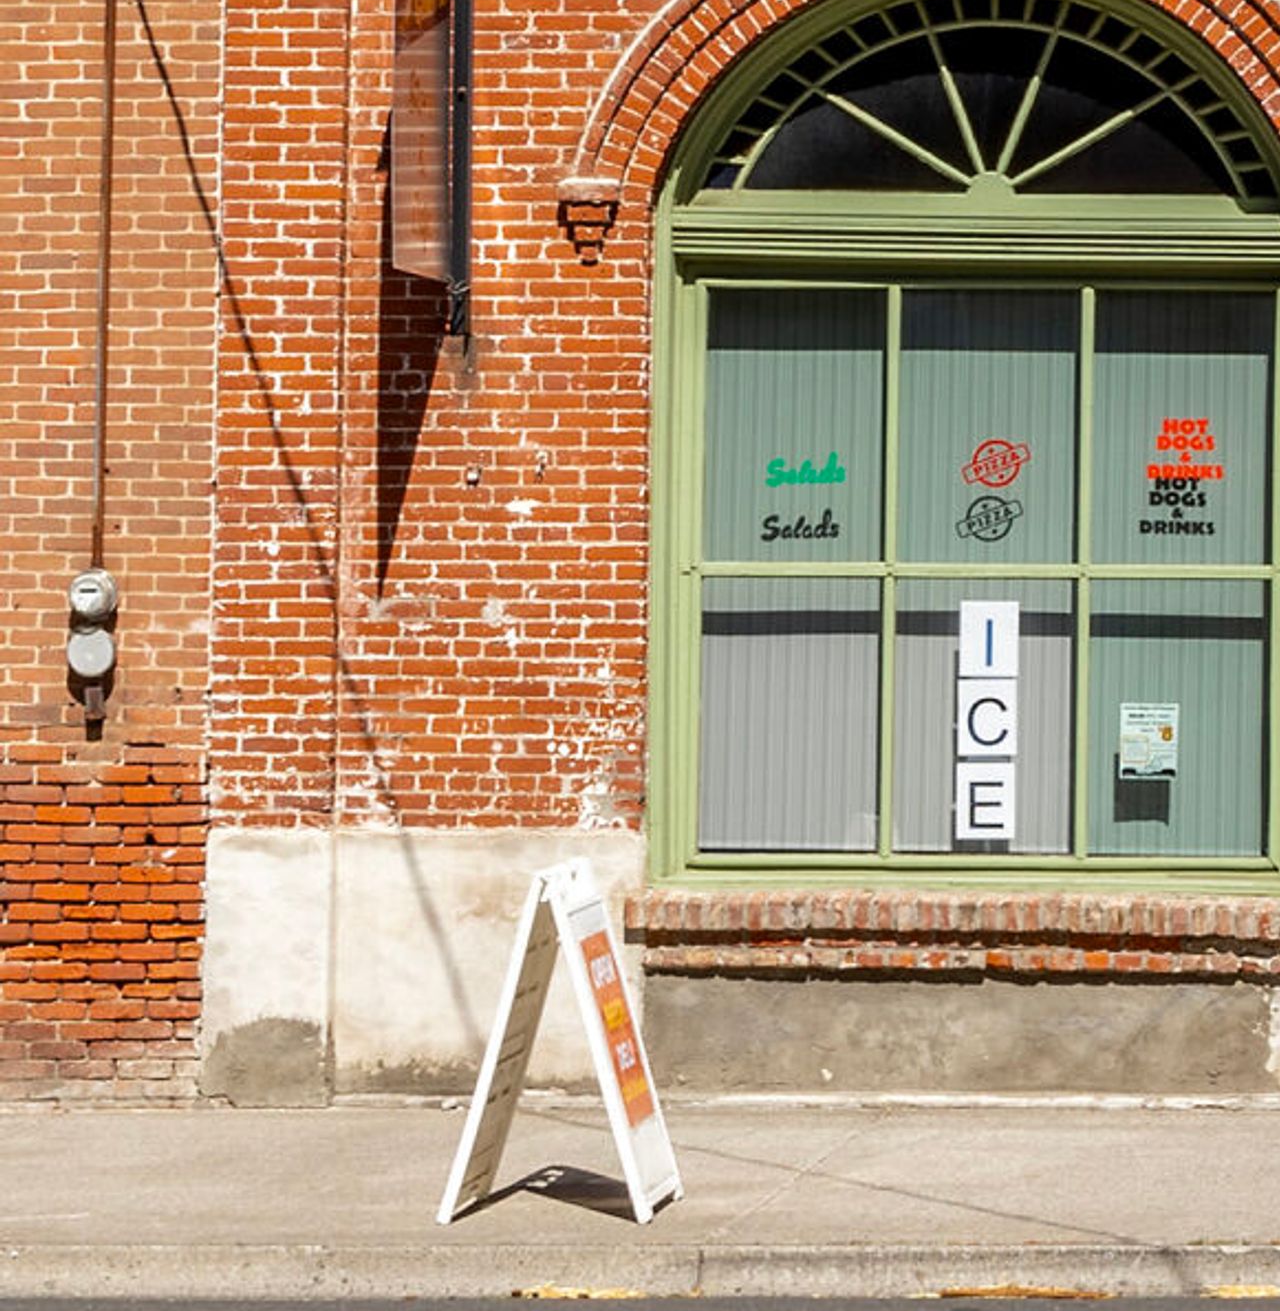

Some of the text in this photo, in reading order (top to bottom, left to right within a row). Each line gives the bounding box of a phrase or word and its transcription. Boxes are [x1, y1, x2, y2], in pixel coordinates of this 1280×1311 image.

[1162, 418, 1209, 435] HOT
[1156, 435, 1215, 451] DOGS
[973, 451, 1020, 478] PIZZA
[1146, 464, 1224, 480] DRINKS
[1148, 491, 1207, 507] DOGS
[760, 508, 841, 543] Salads
[967, 507, 1013, 533] PIZZA
[1139, 519, 1215, 536] DRINKS
[967, 619, 1008, 829] ICE
